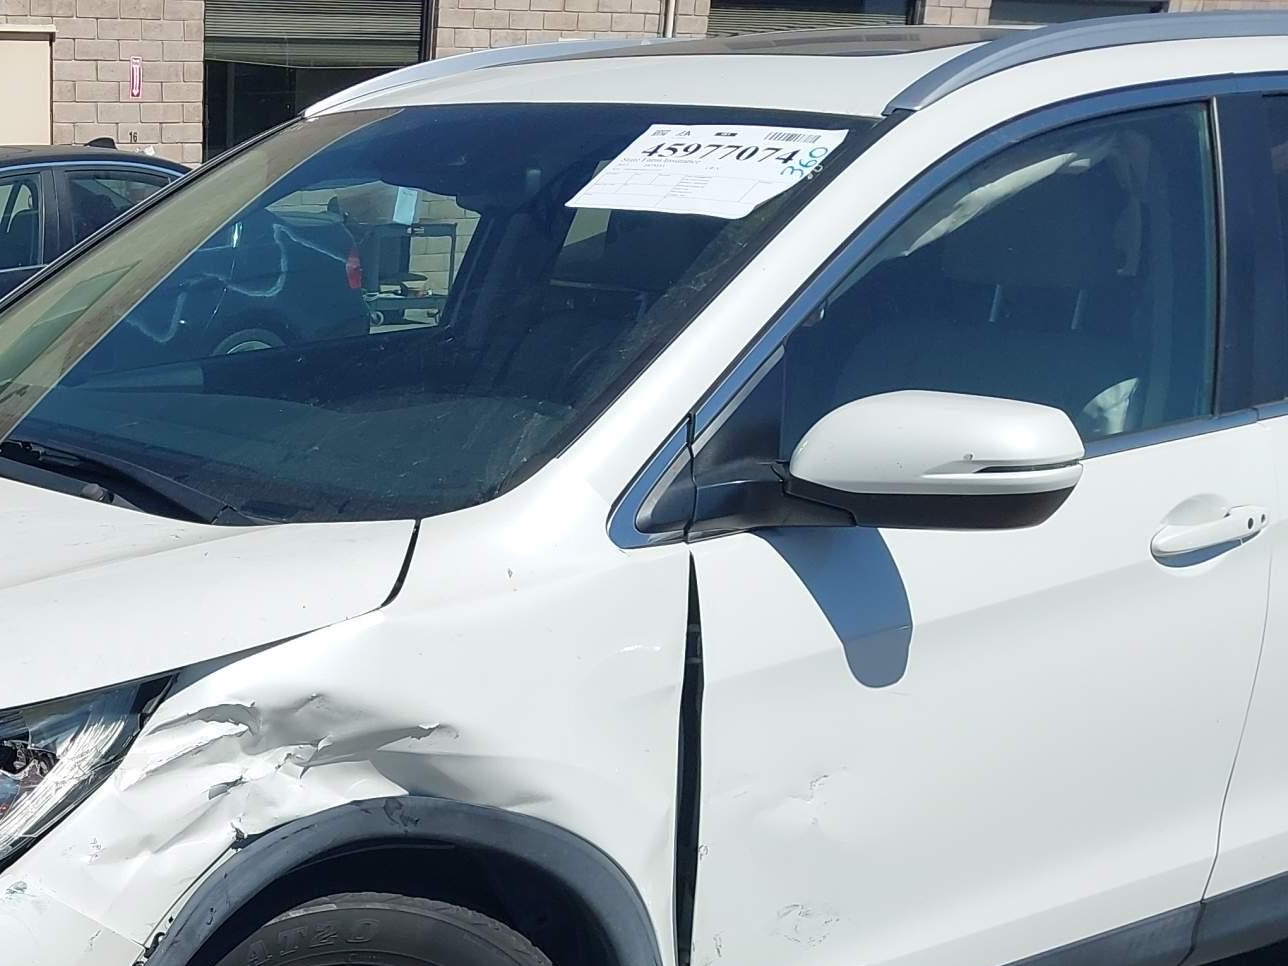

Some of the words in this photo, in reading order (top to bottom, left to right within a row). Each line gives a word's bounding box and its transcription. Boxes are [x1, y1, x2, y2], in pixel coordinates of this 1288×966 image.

[128, 130, 138, 143] 16
[641, 142, 801, 164] 45977074
[780, 146, 829, 178] 360
